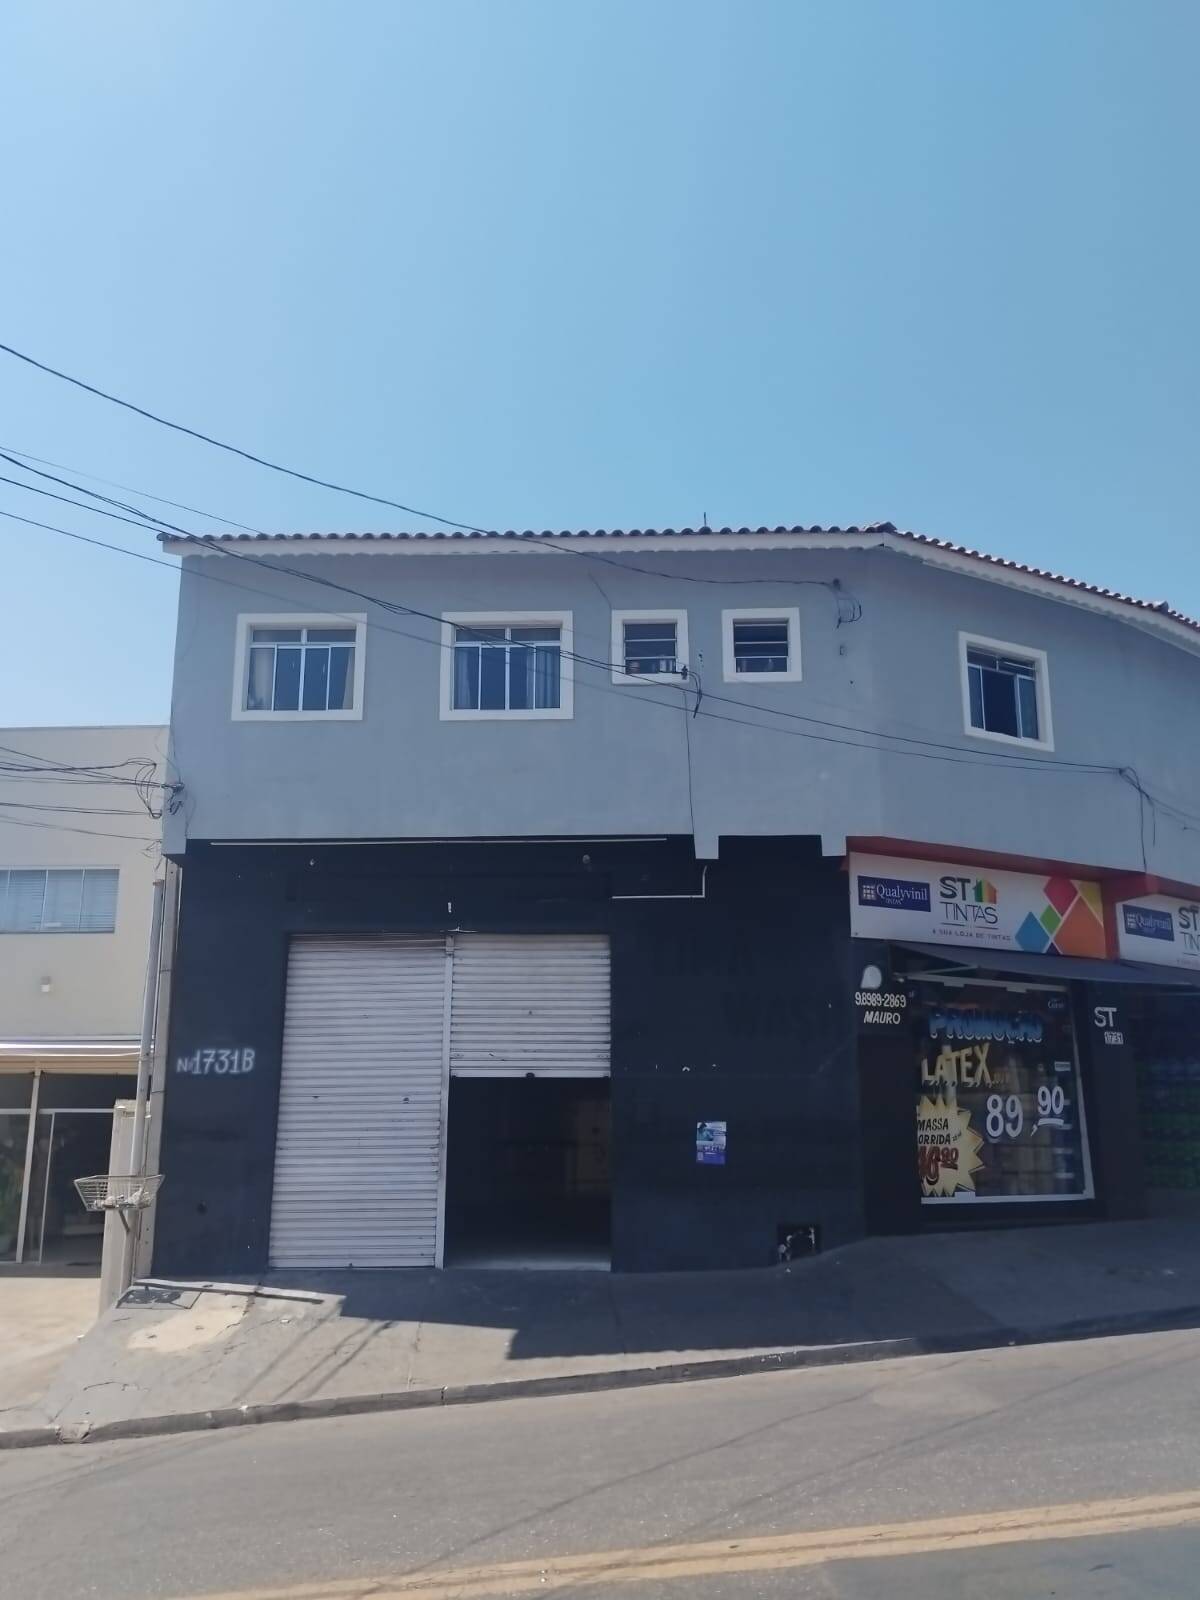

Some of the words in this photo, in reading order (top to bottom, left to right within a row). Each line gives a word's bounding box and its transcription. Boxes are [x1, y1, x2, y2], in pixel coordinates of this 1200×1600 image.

[876, 883, 928, 902] Qualyvinil
[939, 875, 971, 901] ST
[939, 901, 998, 924] TINTAS
[1178, 905, 1200, 931] ST
[863, 1010, 901, 1025] MAURO
[1094, 1006, 1118, 1027] ST
[920, 1042, 992, 1088] LATEX
[918, 1133, 951, 1145] ORRIDA
